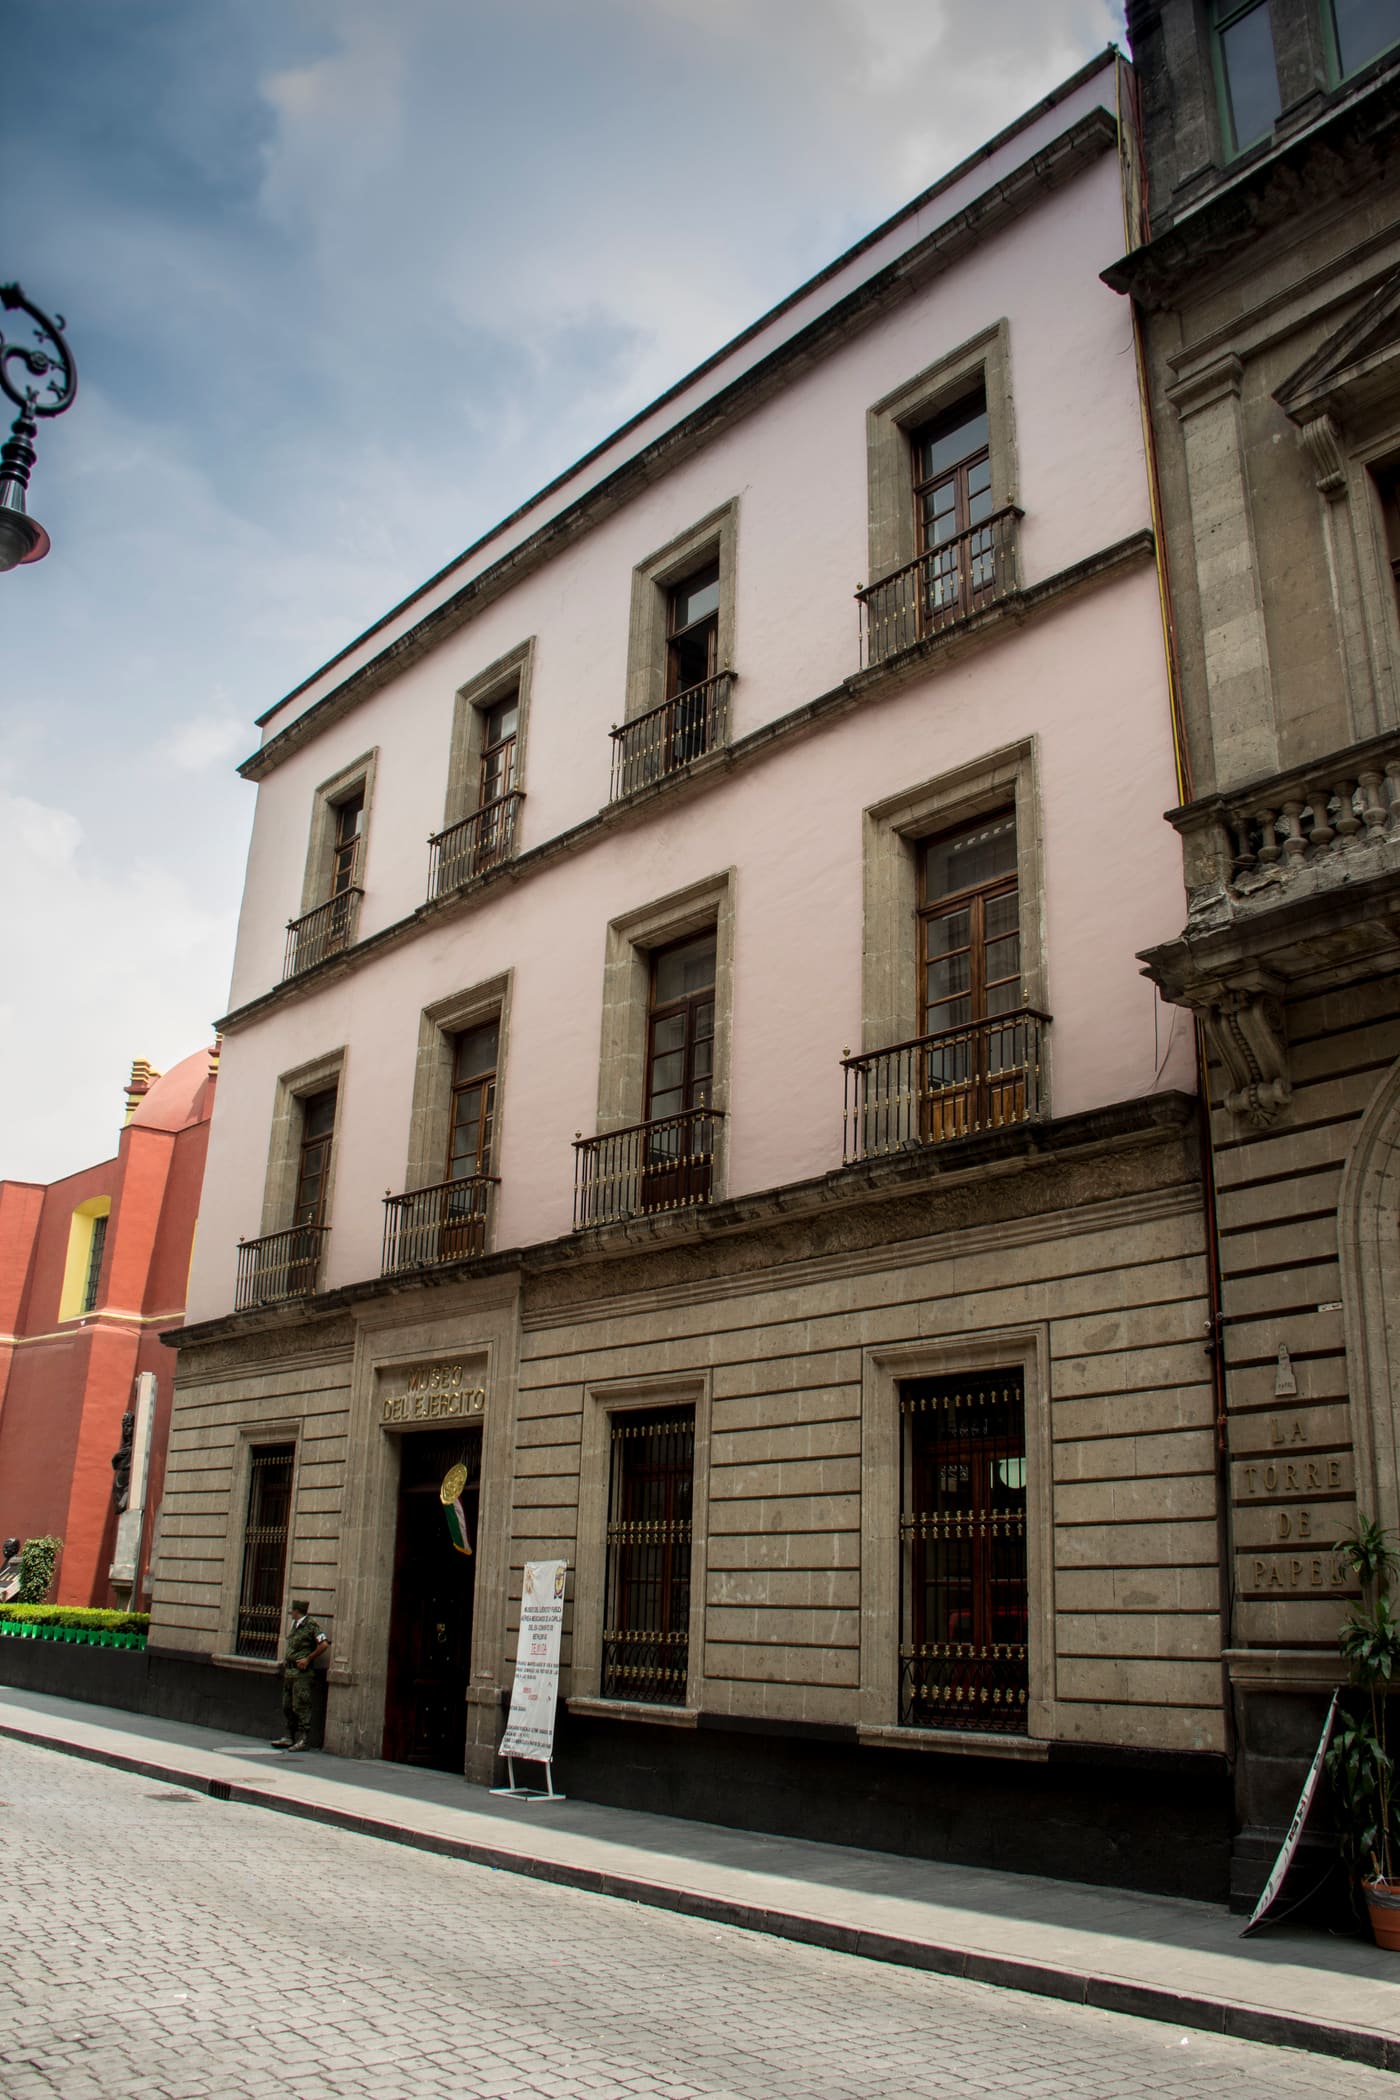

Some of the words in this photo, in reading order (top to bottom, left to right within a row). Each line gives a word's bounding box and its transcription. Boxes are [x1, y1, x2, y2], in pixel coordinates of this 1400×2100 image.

[408, 1364, 463, 1392] MUSEO
[383, 1397, 409, 1420] DEL
[415, 1388, 485, 1418] EJERCITO
[1271, 1417, 1307, 1444] LA
[1244, 1459, 1342, 1493] TORRE
[1279, 1511, 1311, 1538] DE
[1253, 1557, 1344, 1587] PAPEL
